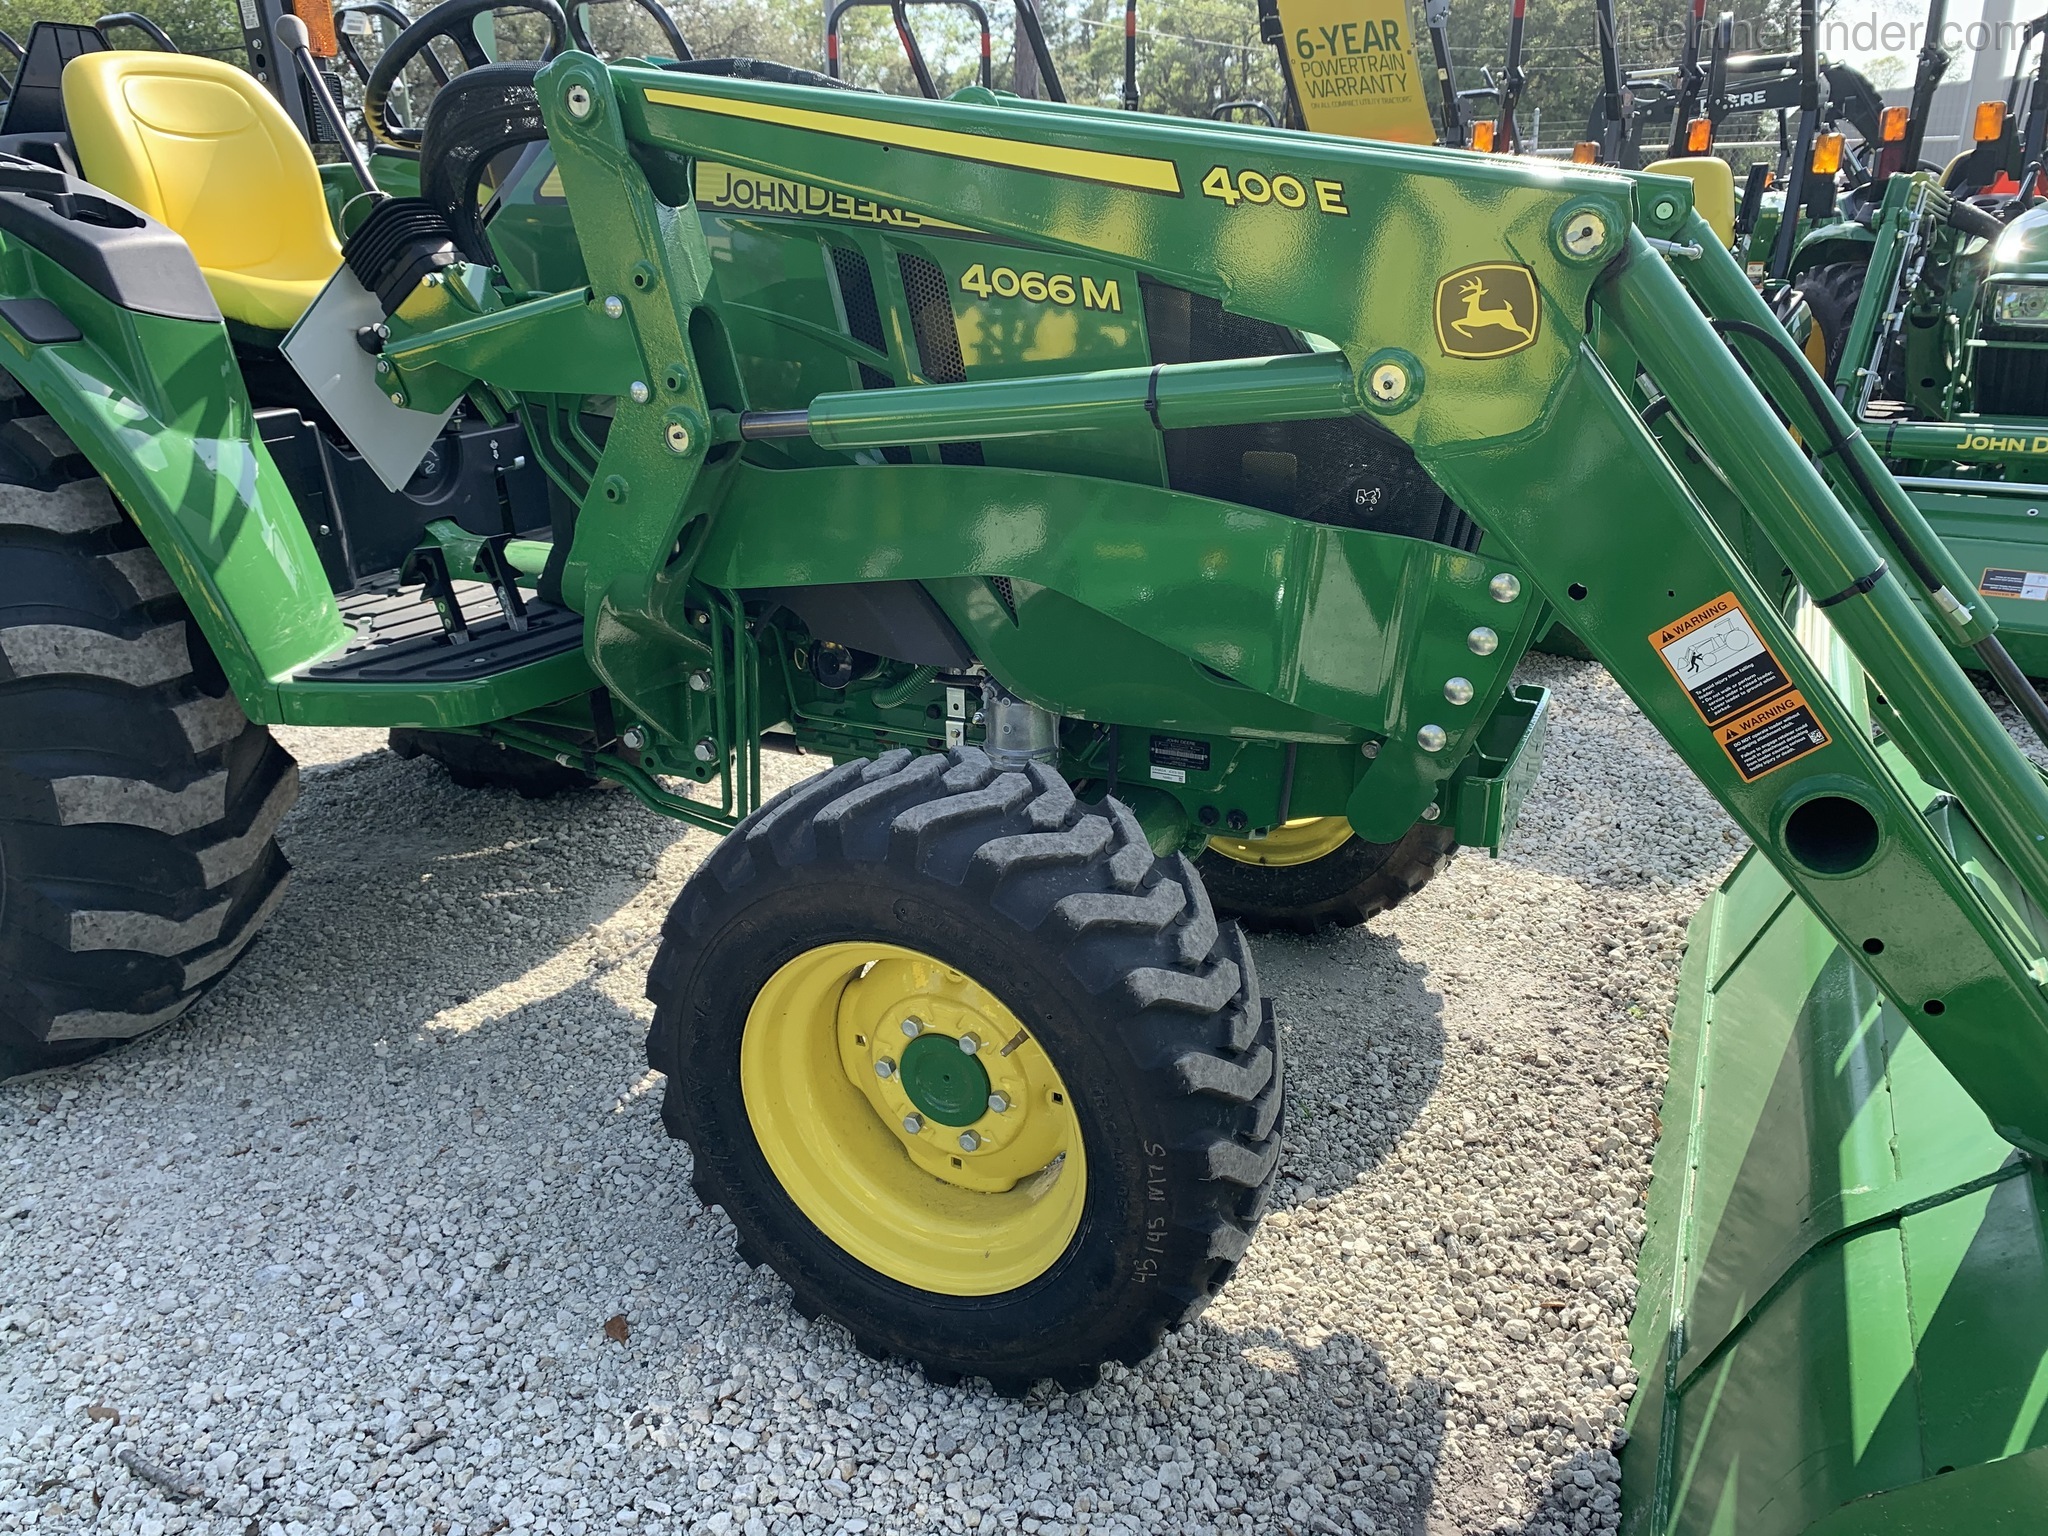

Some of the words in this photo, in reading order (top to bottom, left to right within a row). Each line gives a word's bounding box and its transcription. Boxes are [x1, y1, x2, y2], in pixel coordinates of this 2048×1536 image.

[1296, 19, 1402, 60] 6-YEAR
[1300, 53, 1406, 78] POWERTRAIN
[1305, 73, 1408, 99] WARRANTY
[1957, 434, 2027, 452] JOHN
[1673, 602, 1728, 634] WARNING
[1739, 698, 1794, 731] WARNING
